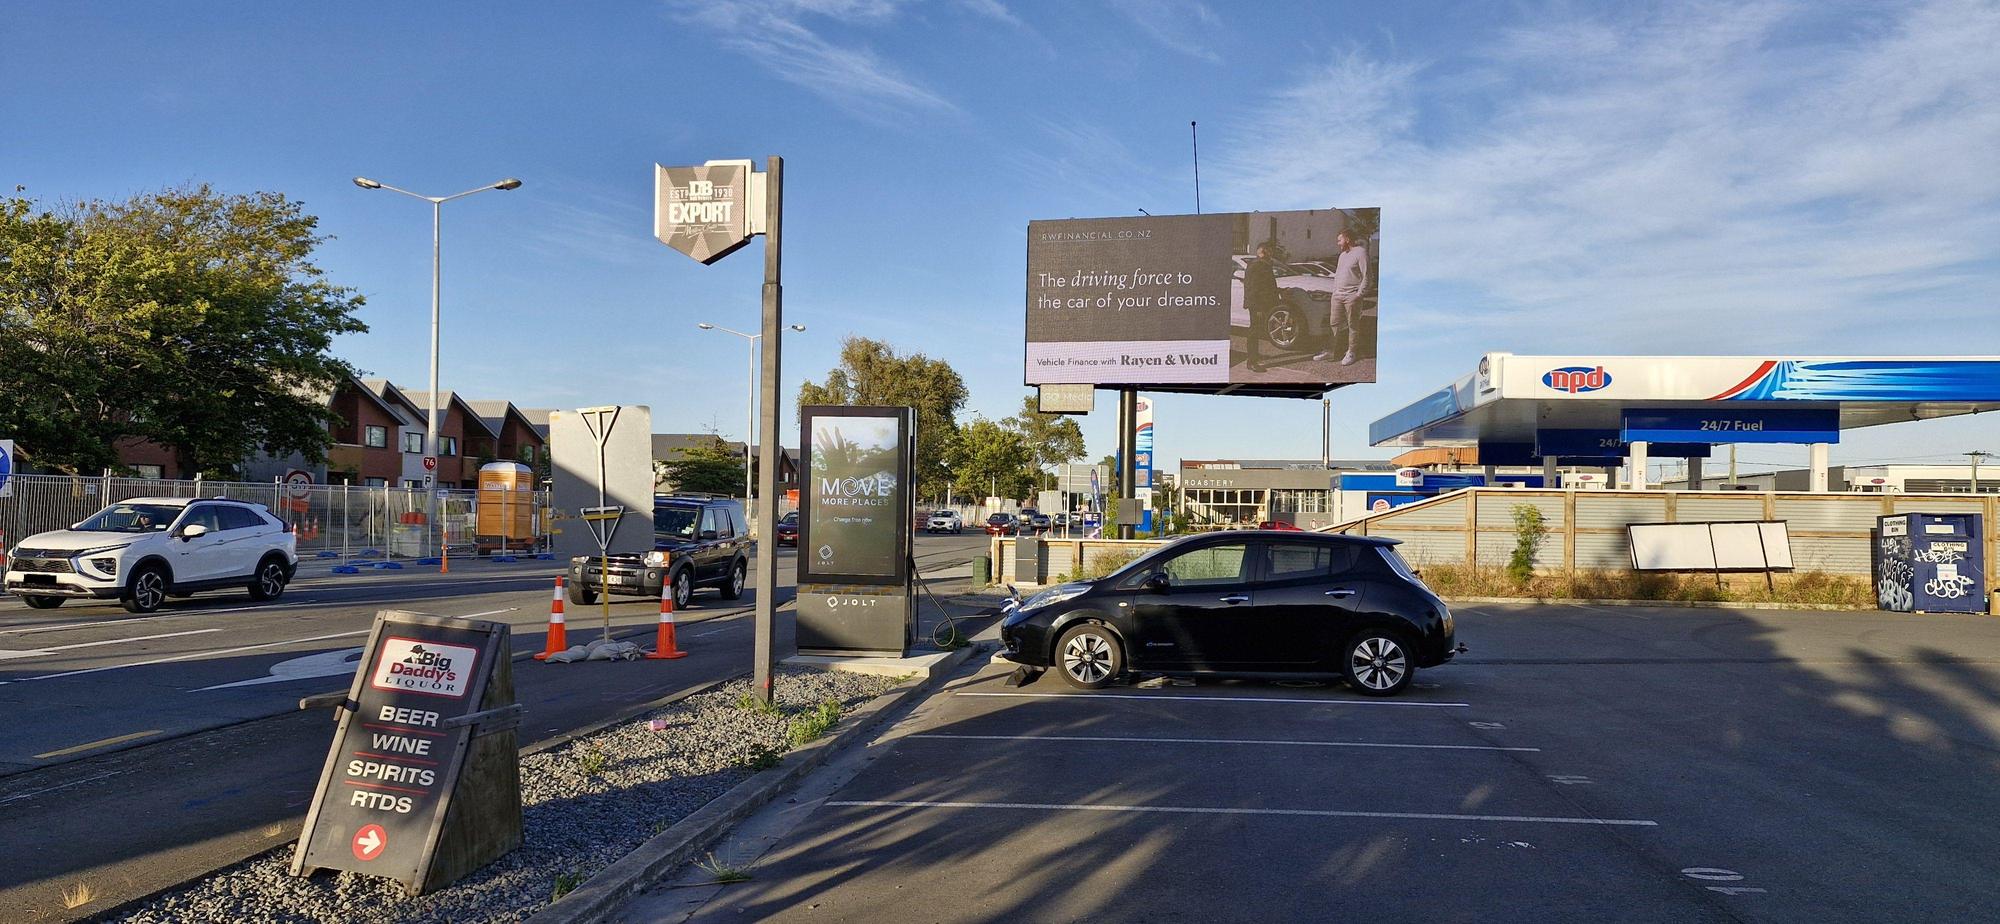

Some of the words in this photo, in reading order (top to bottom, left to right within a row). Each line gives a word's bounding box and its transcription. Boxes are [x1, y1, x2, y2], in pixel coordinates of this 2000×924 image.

[688, 181, 713, 197] DB
[714, 188, 733, 198] 1930
[668, 201, 734, 223] EXPORT
[1039, 273, 1066, 287] The
[1071, 270, 1127, 290] driving
[1129, 268, 1172, 289] force
[1177, 272, 1192, 284] to
[1038, 294, 1061, 309] the
[1067, 297, 1090, 309] car
[1096, 292, 1113, 308] of
[1117, 297, 1152, 311] your
[1157, 291, 1221, 307] dreams.
[1036, 358, 1065, 367] Vehicle
[1067, 357, 1098, 366] Finance
[1100, 357, 1117, 366] with
[1120, 354, 1162, 368] Rayen
[1165, 354, 1176, 366] &
[1179, 354, 1218, 366] Wood
[1551, 366, 1603, 393] npd
[1700, 420, 1731, 431] 24/7
[1734, 420, 1763, 431] Fuel
[425, 458, 434, 466] 76
[822, 477, 889, 497] MOVE
[1184, 479, 1234, 487] ROASTERY
[822, 498, 849, 506] MORE
[853, 498, 889, 506] PLACES
[842, 599, 876, 607] JOLT
[423, 653, 451, 669] Big
[390, 662, 456, 684] Daddy's
[385, 677, 455, 692] LIQUOR
[378, 705, 440, 728] BEER
[372, 733, 432, 756] WINE
[347, 760, 435, 786] SPIRITS
[350, 790, 413, 814] RTDS
